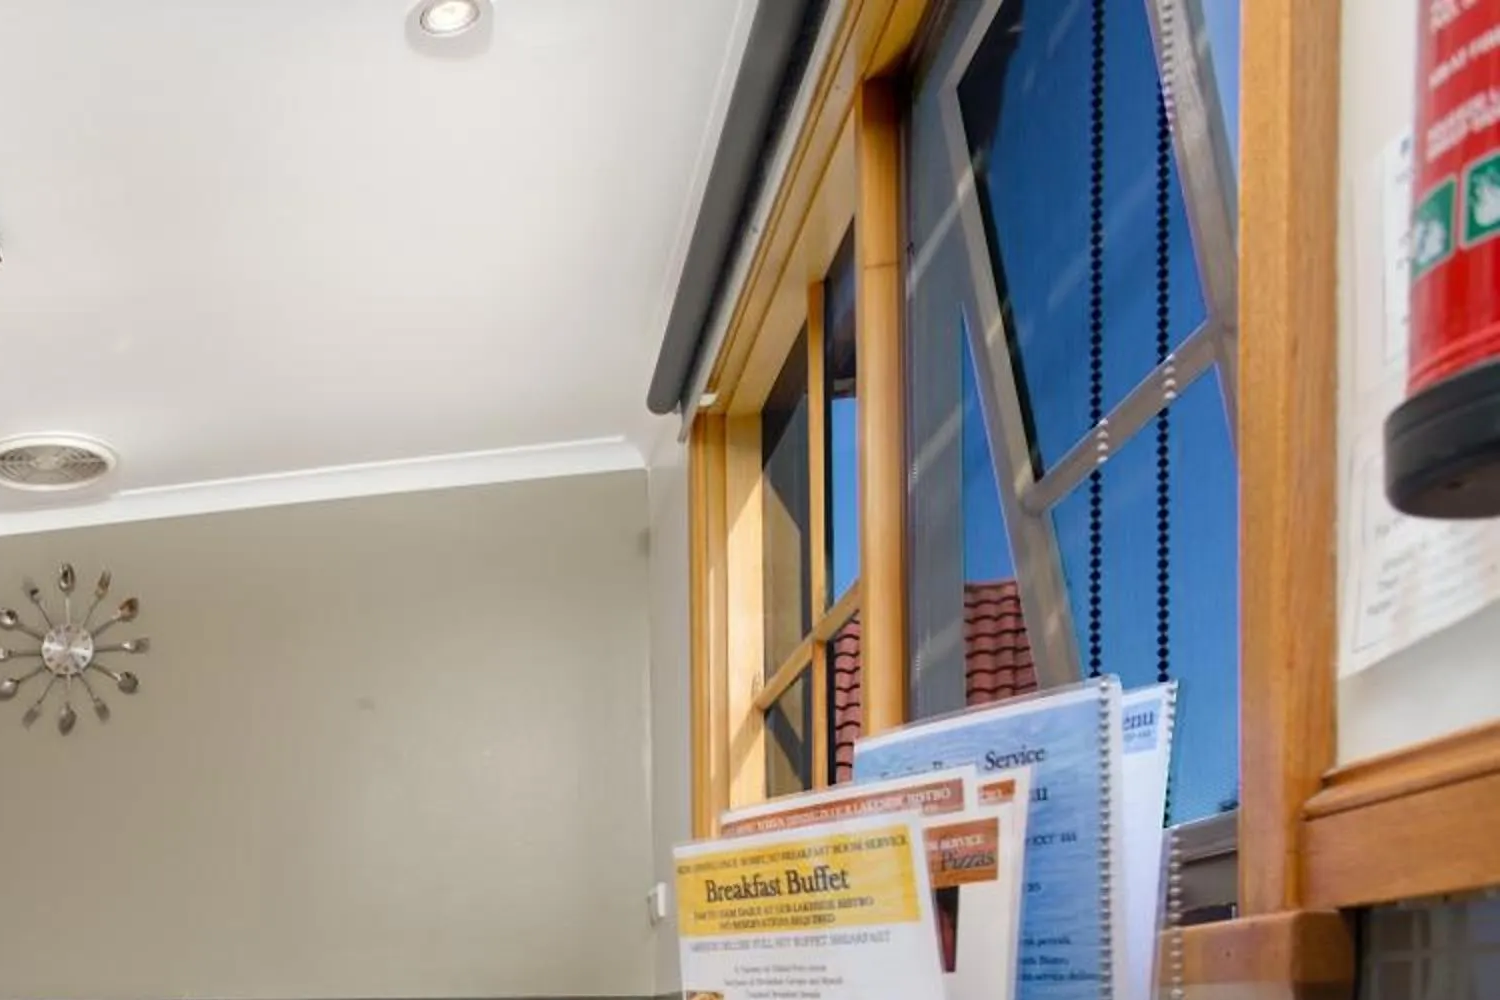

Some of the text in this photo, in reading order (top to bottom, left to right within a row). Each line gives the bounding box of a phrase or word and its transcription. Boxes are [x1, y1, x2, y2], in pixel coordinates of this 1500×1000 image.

[1123, 711, 1154, 732] enu
[984, 744, 1046, 771] Service
[864, 833, 908, 851] SERVICE
[939, 849, 996, 873] Pizzas
[705, 864, 850, 904] Breakfast Buffet
